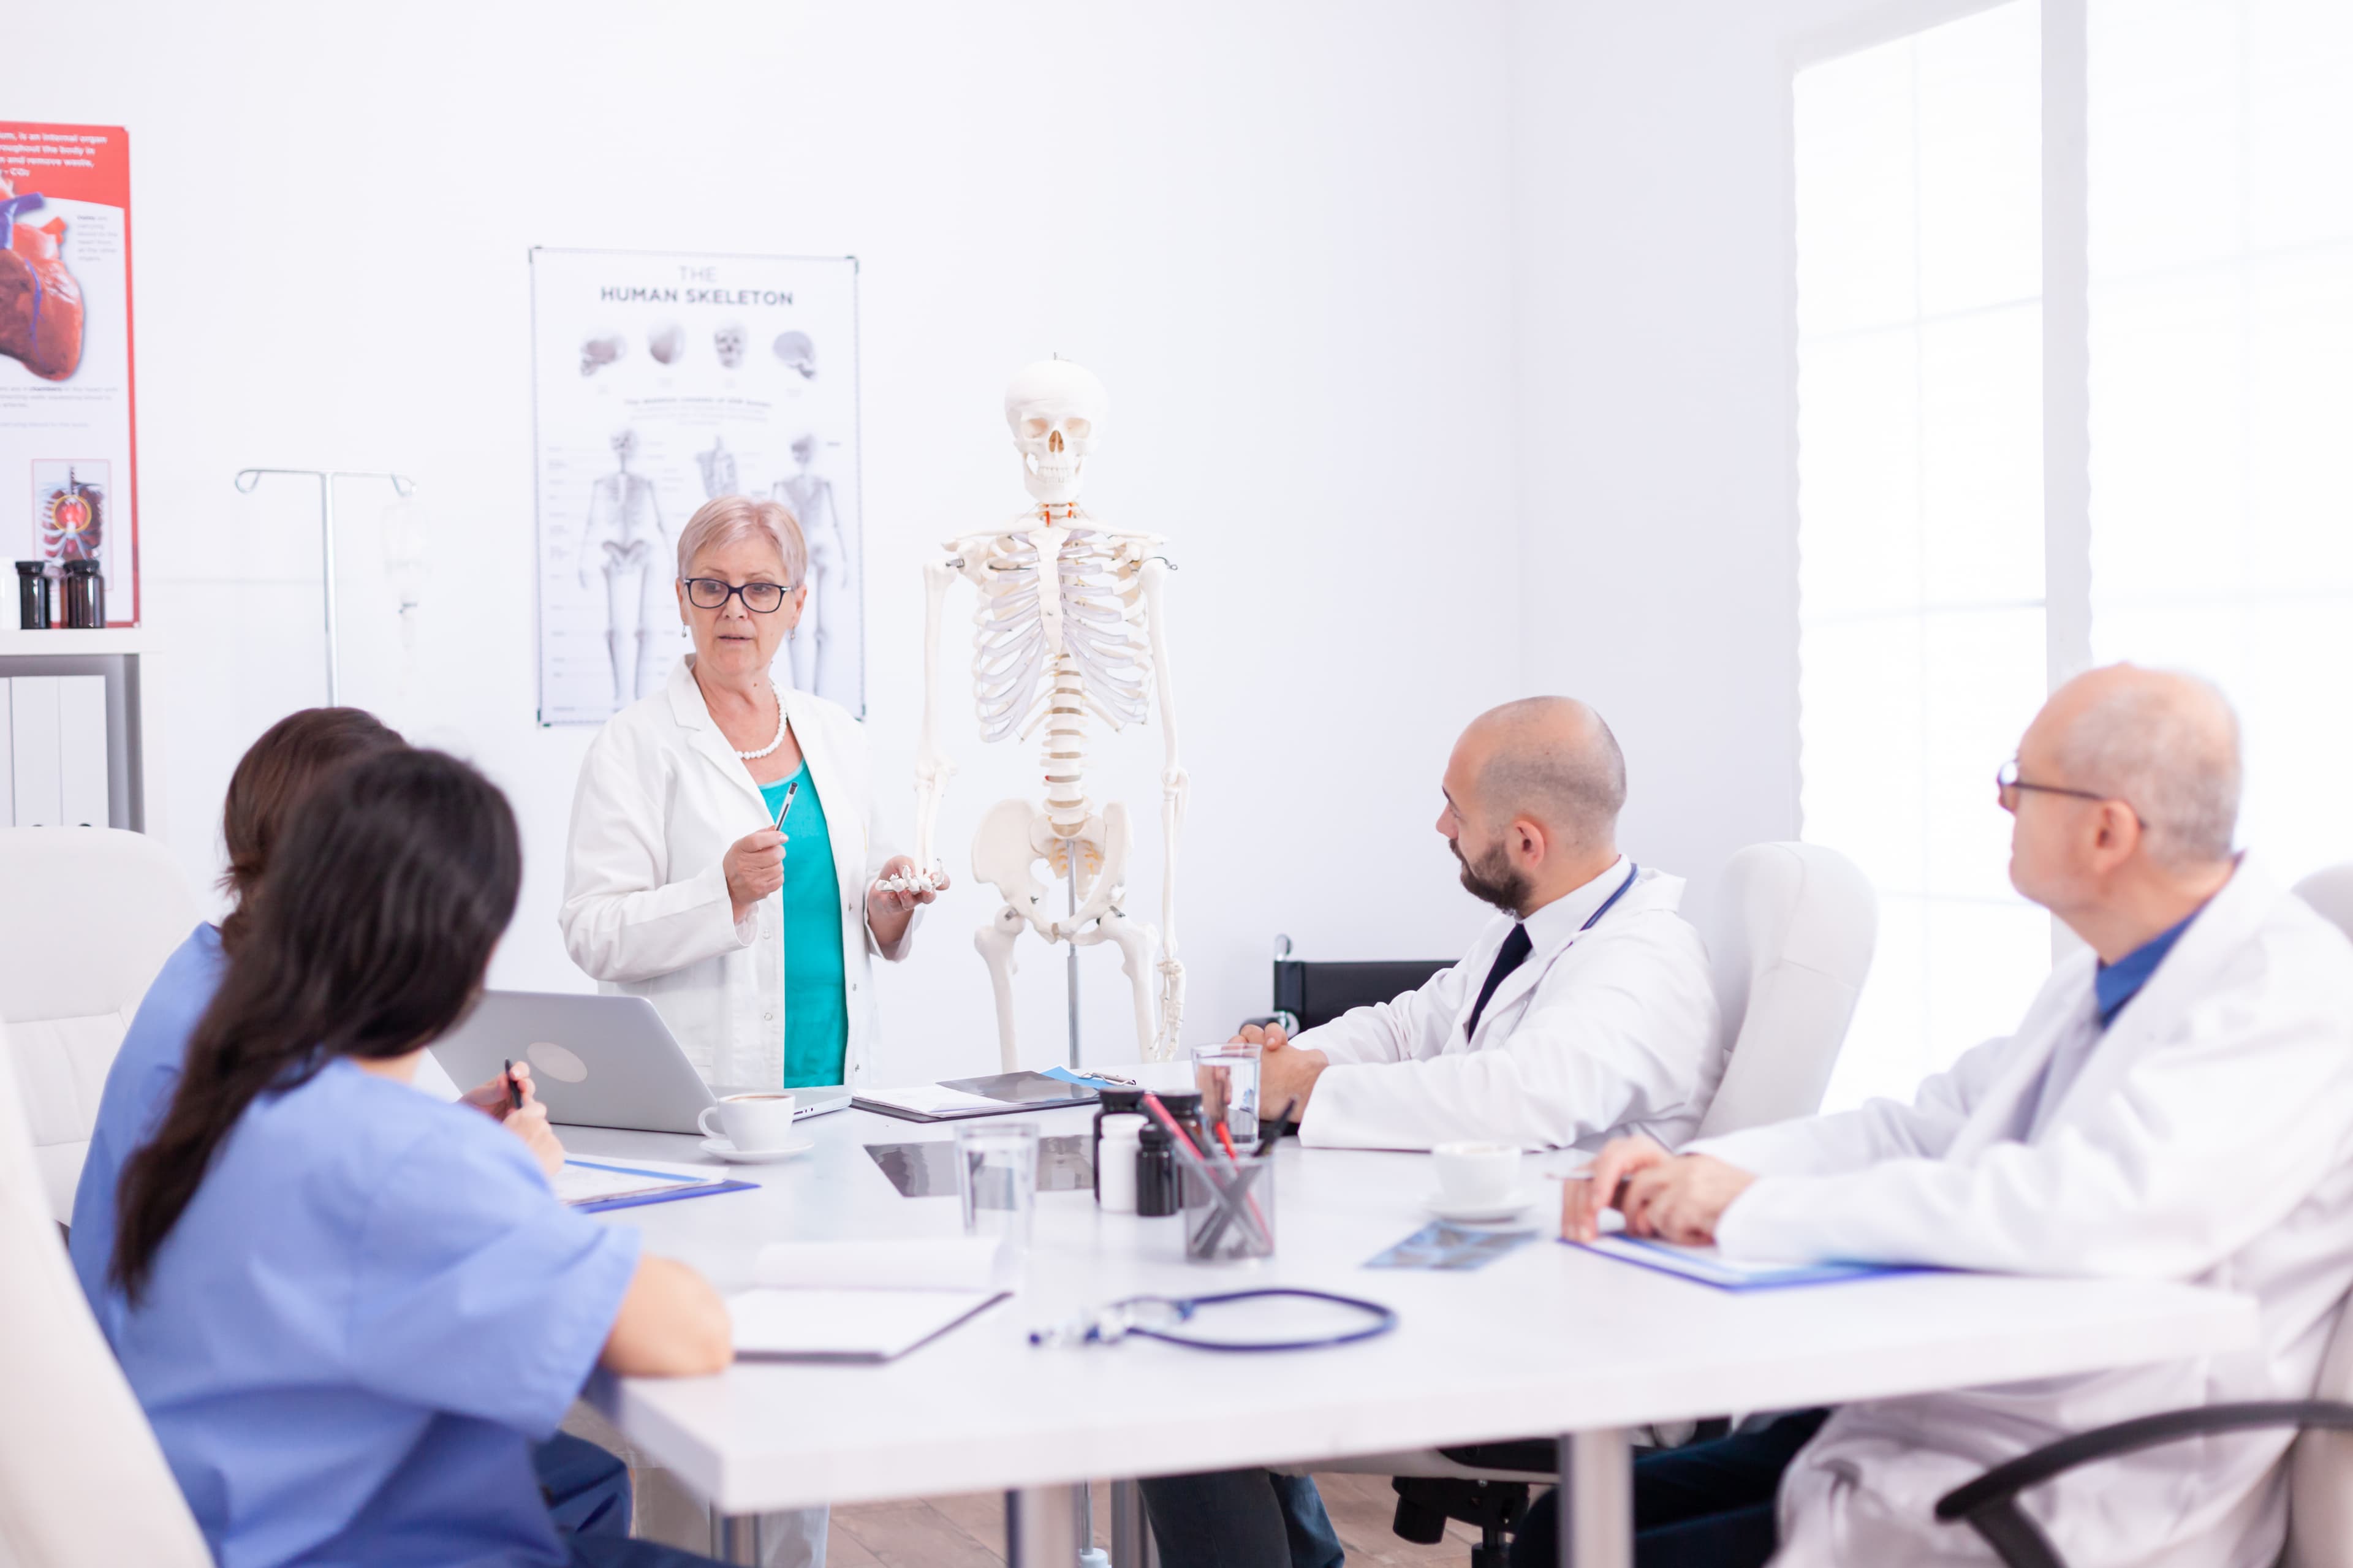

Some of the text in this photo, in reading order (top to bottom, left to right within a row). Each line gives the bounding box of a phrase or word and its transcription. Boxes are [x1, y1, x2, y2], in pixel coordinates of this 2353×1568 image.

[42, 132, 79, 142] internal
[80, 135, 108, 145] organ
[42, 145, 59, 154] the
[59, 145, 85, 156] body
[678, 265, 716, 283] THE
[601, 286, 794, 305] HUMAN SKELETON
